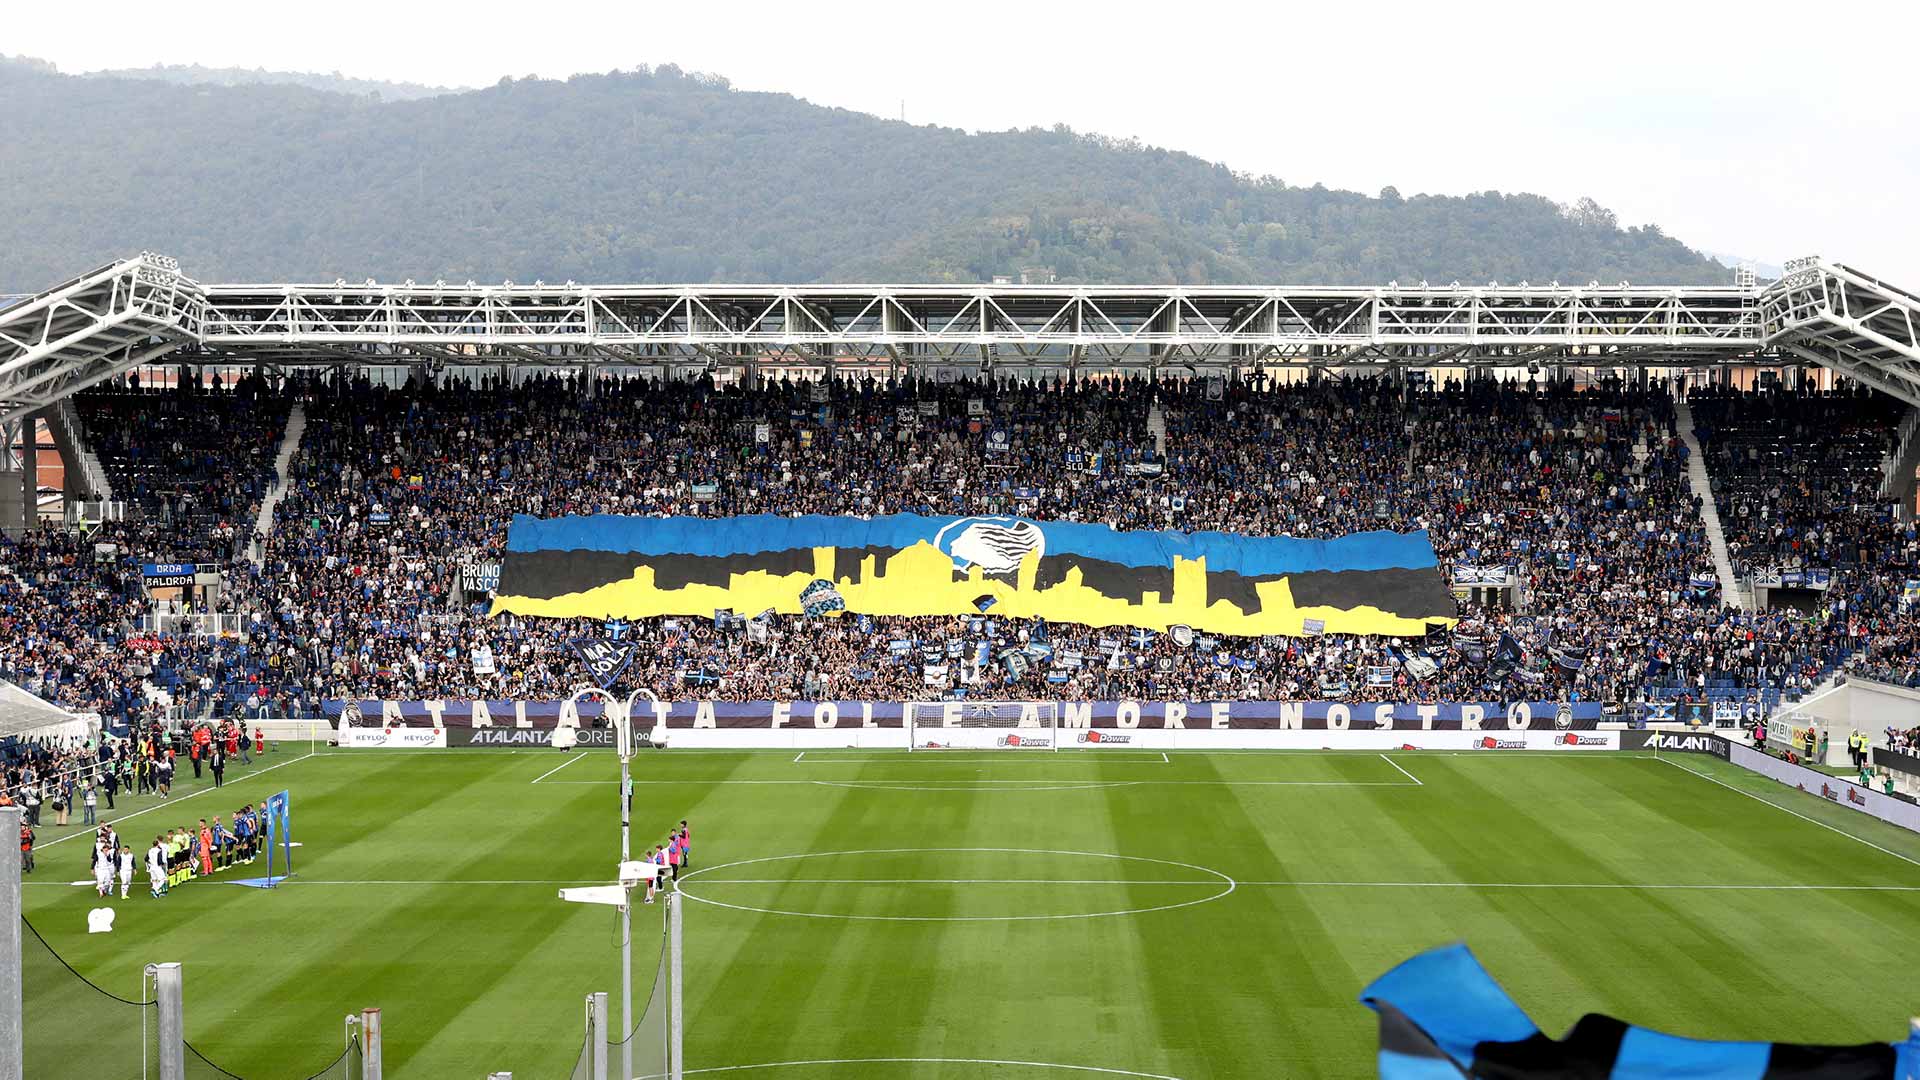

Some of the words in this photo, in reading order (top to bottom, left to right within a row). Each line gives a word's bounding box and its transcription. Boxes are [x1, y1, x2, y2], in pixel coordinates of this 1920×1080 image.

[157, 565, 182, 573] ORDA
[463, 564, 500, 577] BRUNO
[146, 576, 193, 587] BALORDA
[463, 577, 500, 591] VASCO
[582, 640, 615, 661] MAI
[591, 646, 629, 676] SOLA
[1018, 702, 1230, 729] AMORE
[1279, 702, 1532, 730] NOSTRO
[1772, 721, 1788, 736] VIBI
[470, 730, 553, 743] ATALANTA
